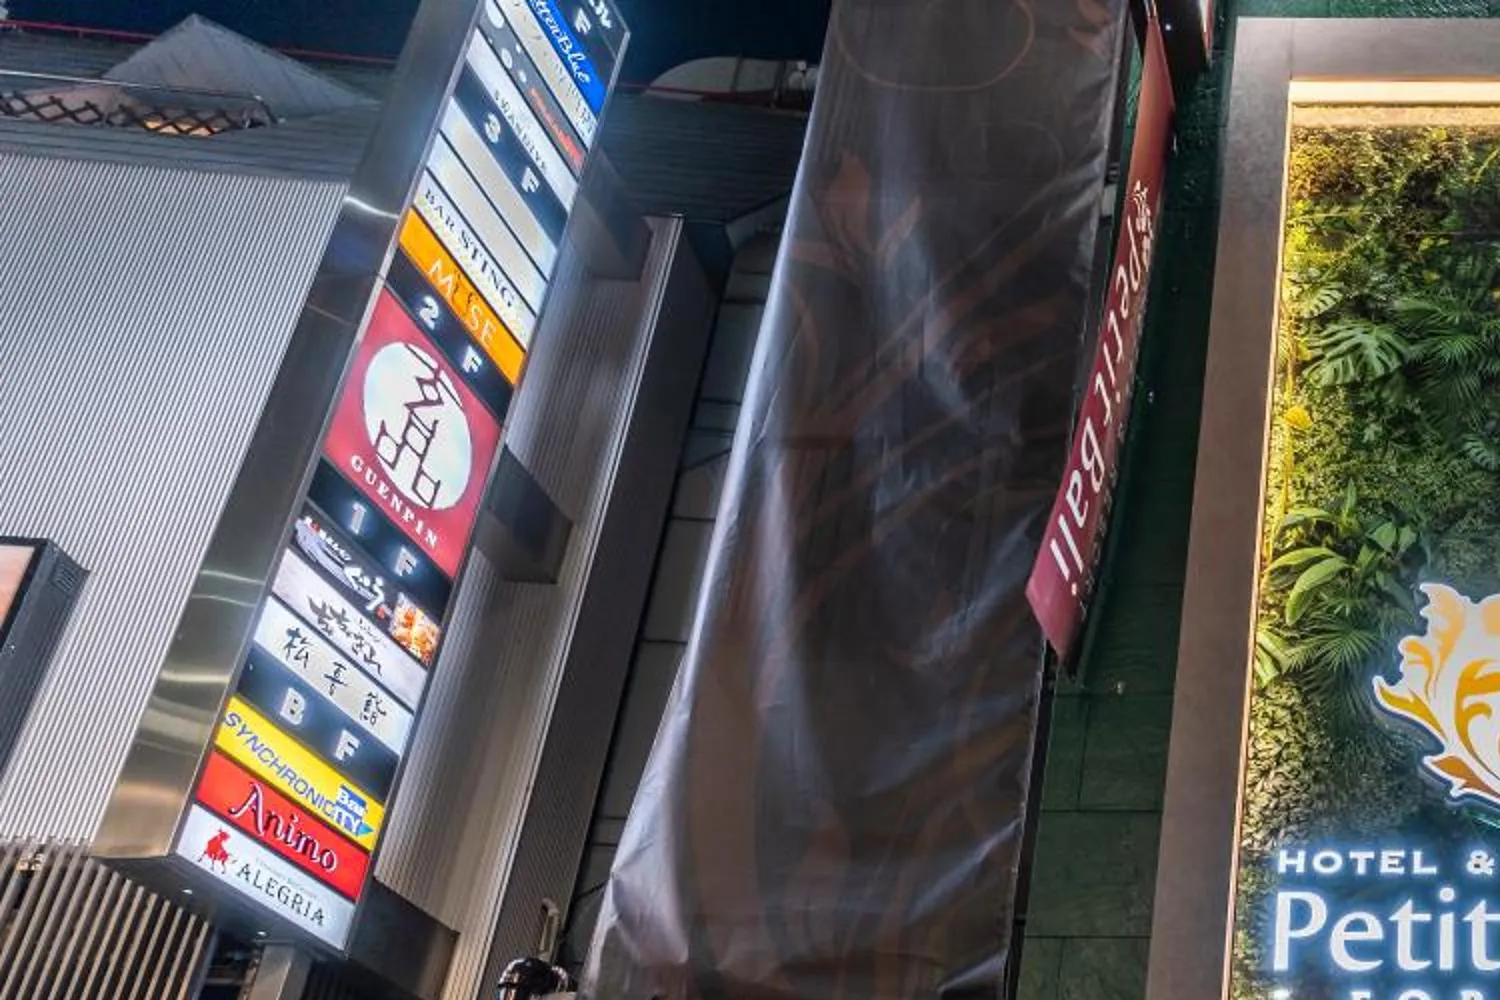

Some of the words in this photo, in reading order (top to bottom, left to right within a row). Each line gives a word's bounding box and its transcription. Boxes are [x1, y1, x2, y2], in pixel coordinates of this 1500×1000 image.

[351, 455, 437, 549] GUENPIN
[1050, 416, 1106, 597] Bali
[224, 711, 361, 836] SYNCHRONICITY
[228, 782, 339, 873] Animo
[1277, 849, 1438, 876] HOTEL
[1466, 849, 1495, 876] &
[236, 862, 326, 927] ALEGRIA
